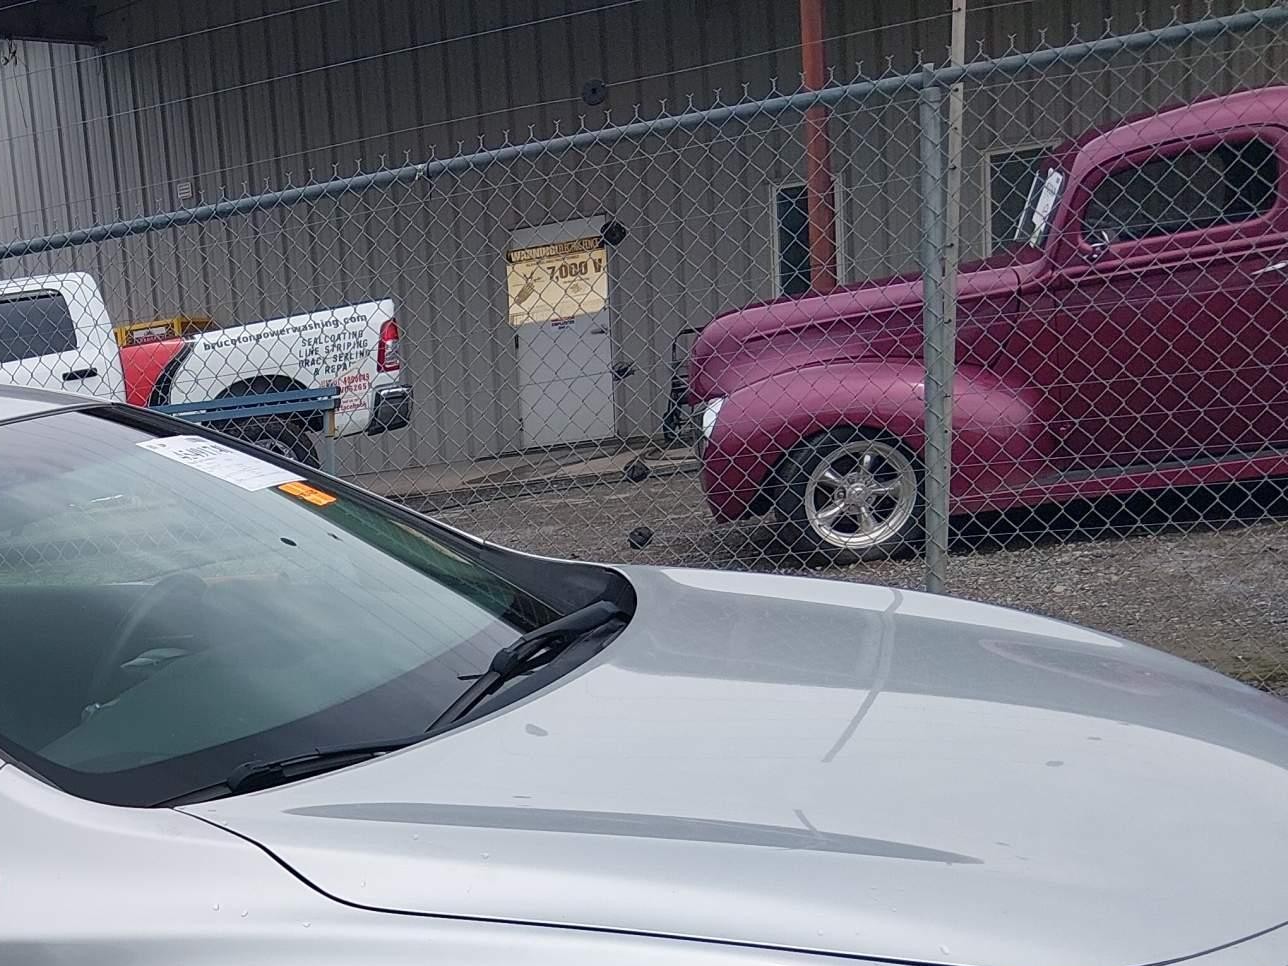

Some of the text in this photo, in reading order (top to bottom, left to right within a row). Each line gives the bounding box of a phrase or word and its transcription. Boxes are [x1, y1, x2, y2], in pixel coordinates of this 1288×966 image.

[546, 261, 588, 282] 7,000
[301, 329, 364, 347] SEALCOATING
[298, 339, 368, 358] LINE STRIPING
